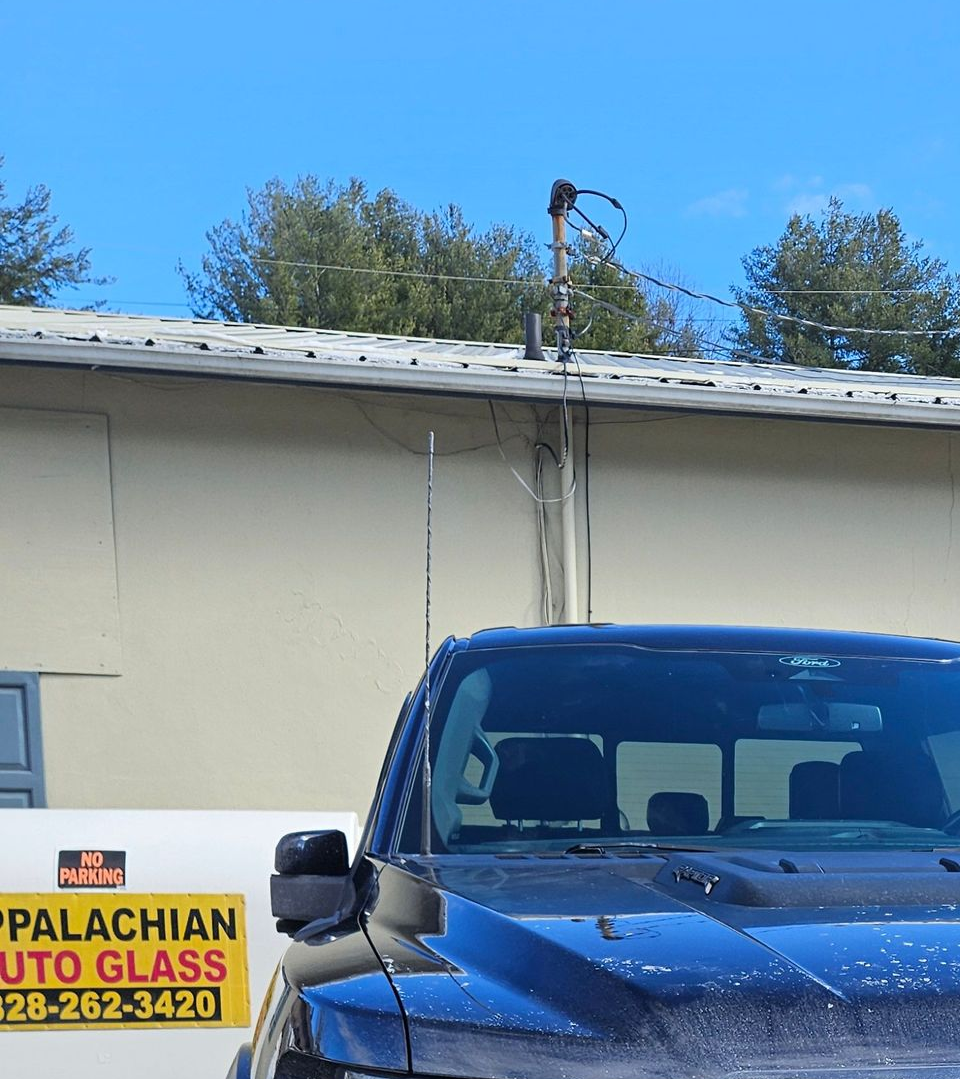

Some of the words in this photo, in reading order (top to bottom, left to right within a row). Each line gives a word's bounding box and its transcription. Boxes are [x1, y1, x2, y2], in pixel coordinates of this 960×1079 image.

[81, 851, 104, 868] NO
[60, 867, 124, 885] PARKING
[96, 950, 228, 983] GLASS
